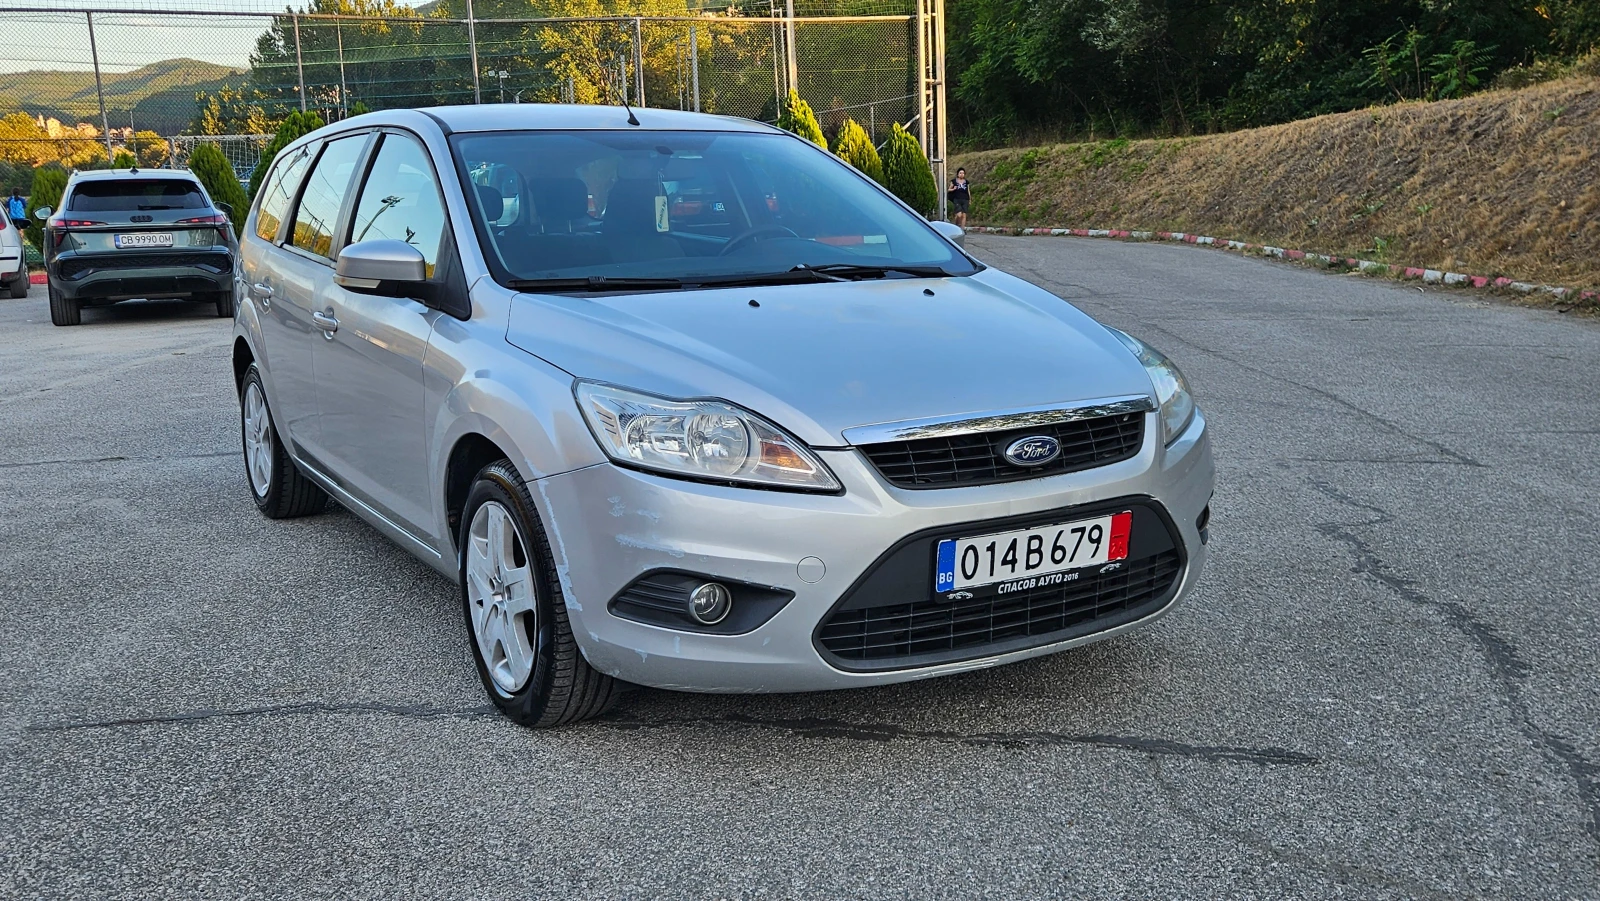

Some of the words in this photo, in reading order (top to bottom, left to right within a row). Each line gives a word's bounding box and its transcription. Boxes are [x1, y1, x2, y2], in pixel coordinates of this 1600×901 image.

[121, 235, 134, 245] CB
[135, 235, 157, 244] 9990
[159, 235, 171, 243] OM
[1022, 442, 1051, 459] Ford
[939, 571, 953, 584] BG
[997, 578, 1036, 594] СПАСОВ
[1038, 573, 1063, 587] АУТО
[1063, 572, 1079, 582] 2016
